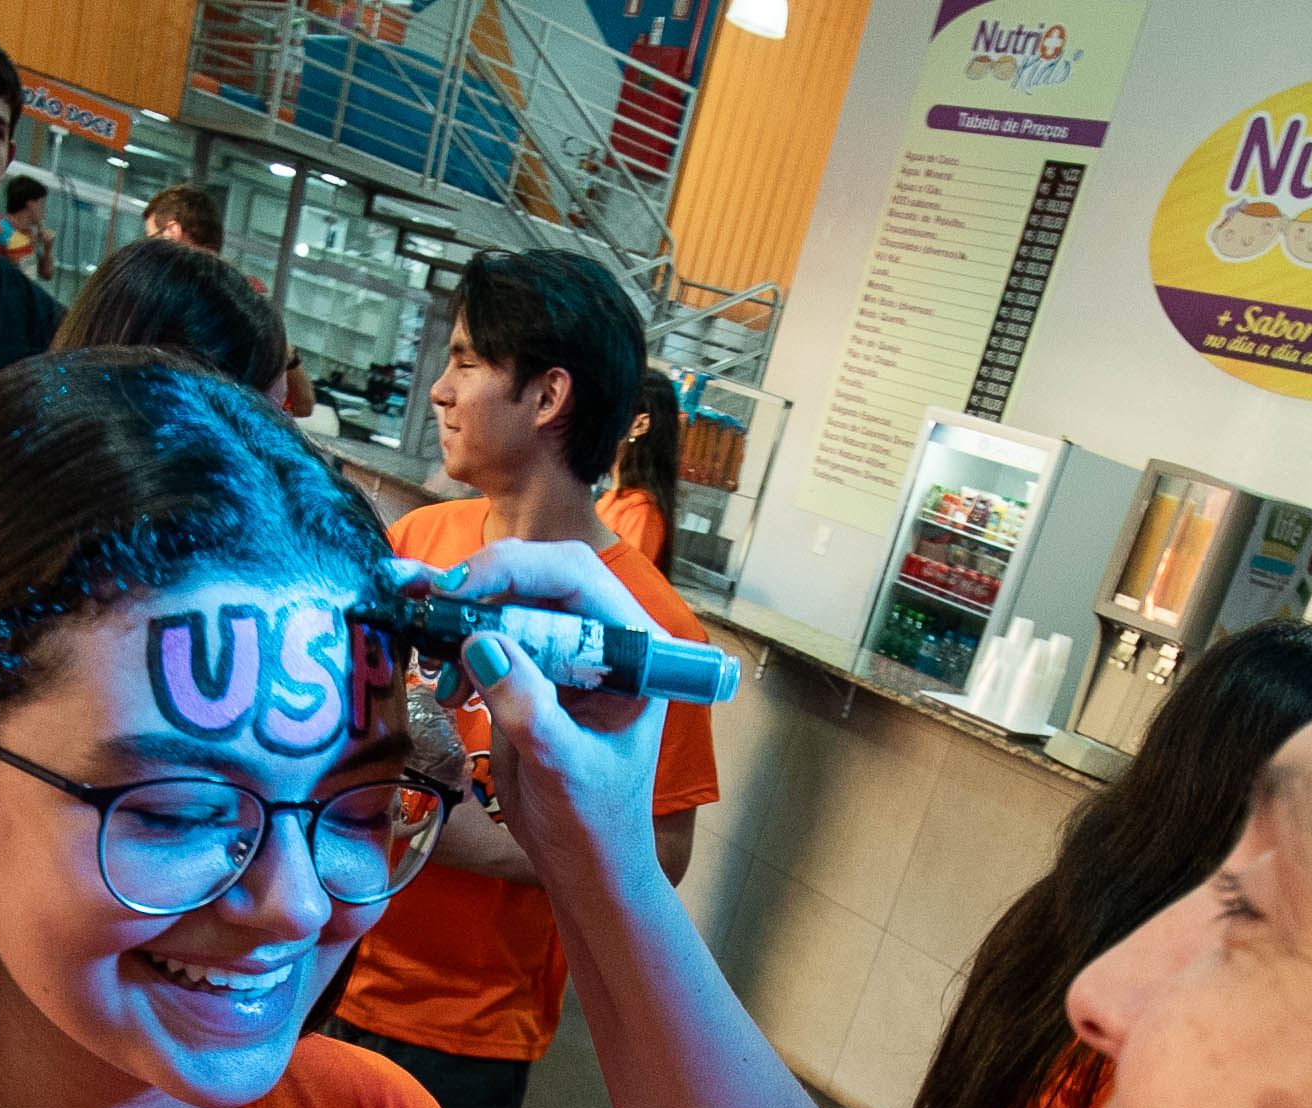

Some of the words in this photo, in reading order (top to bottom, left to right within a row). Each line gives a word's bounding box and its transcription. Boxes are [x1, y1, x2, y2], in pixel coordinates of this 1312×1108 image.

[971, 19, 1046, 55] Nutri
[1202, 331, 1226, 351] no
[1227, 334, 1255, 357] dia
[1271, 342, 1300, 365] dia
[148, 603, 394, 758] USP
